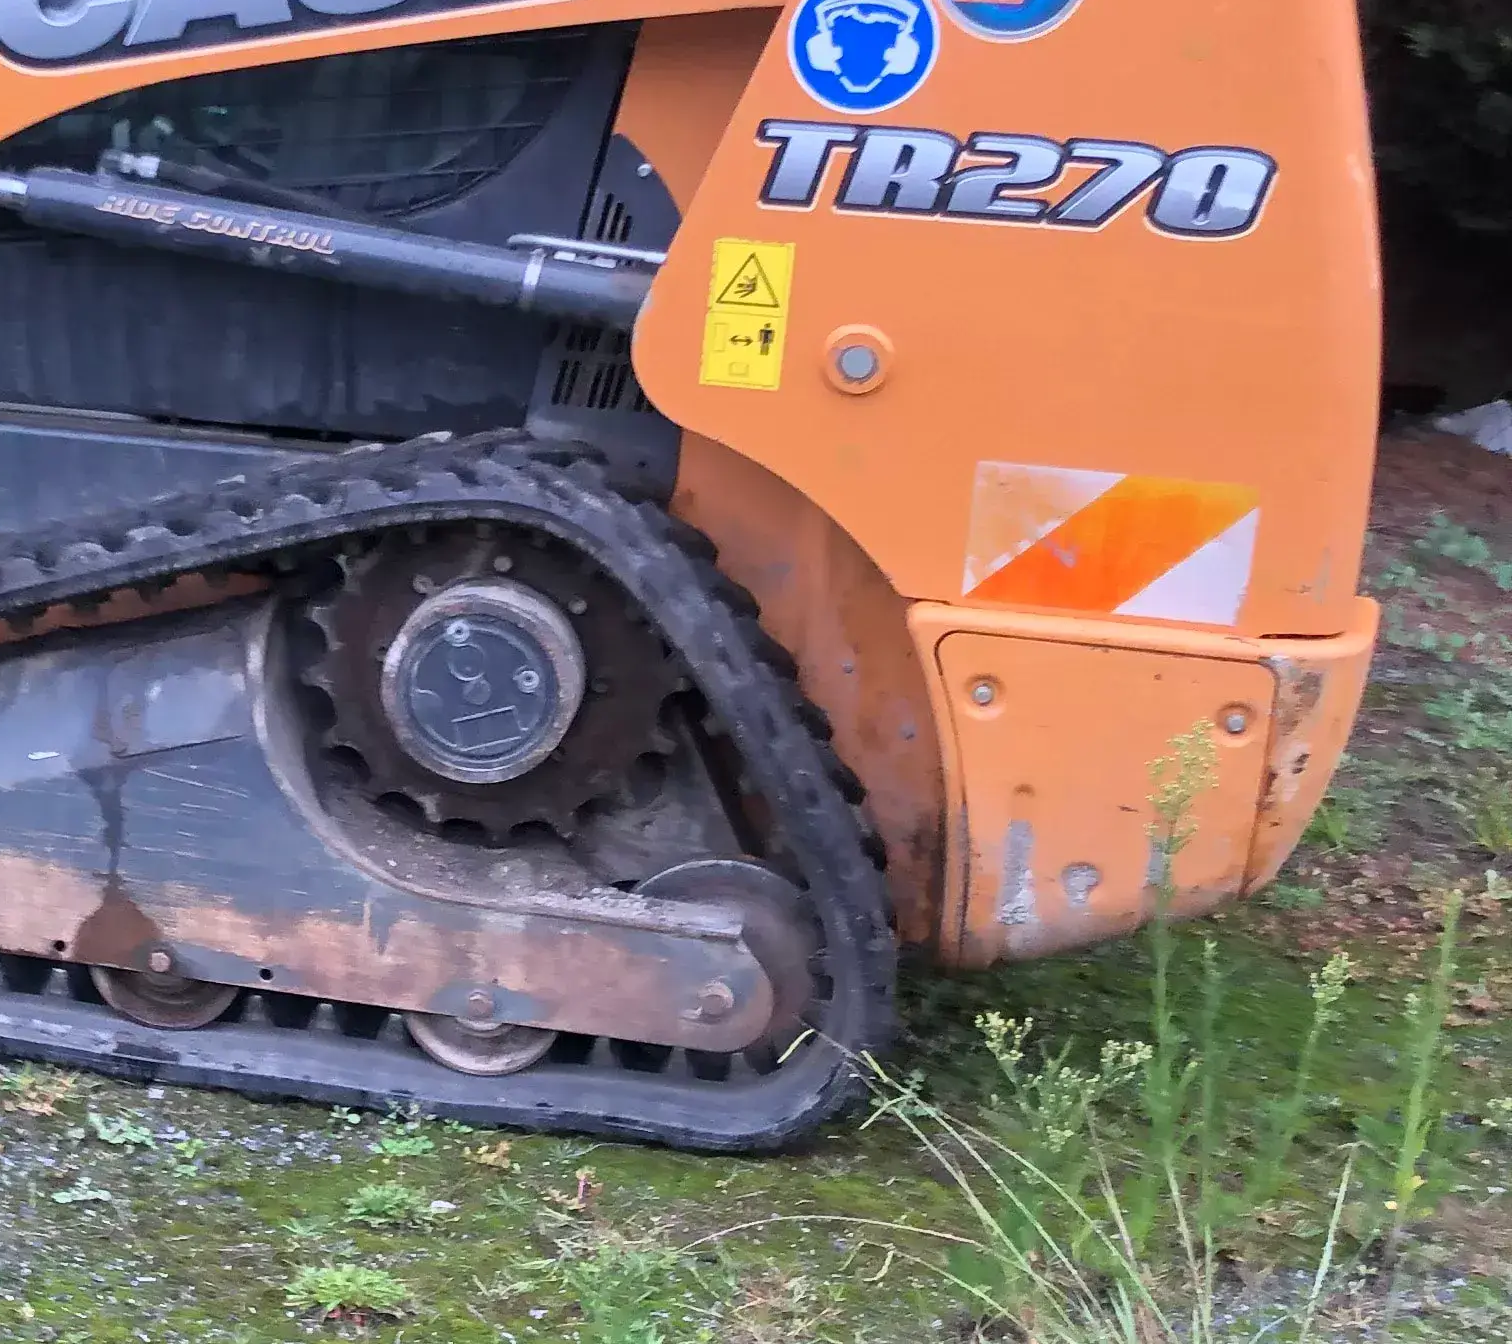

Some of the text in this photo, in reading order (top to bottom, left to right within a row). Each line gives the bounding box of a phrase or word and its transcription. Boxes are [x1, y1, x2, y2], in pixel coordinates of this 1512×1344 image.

[756, 119, 1277, 239] TR270
[95, 196, 336, 255] RIDE CONTROL
